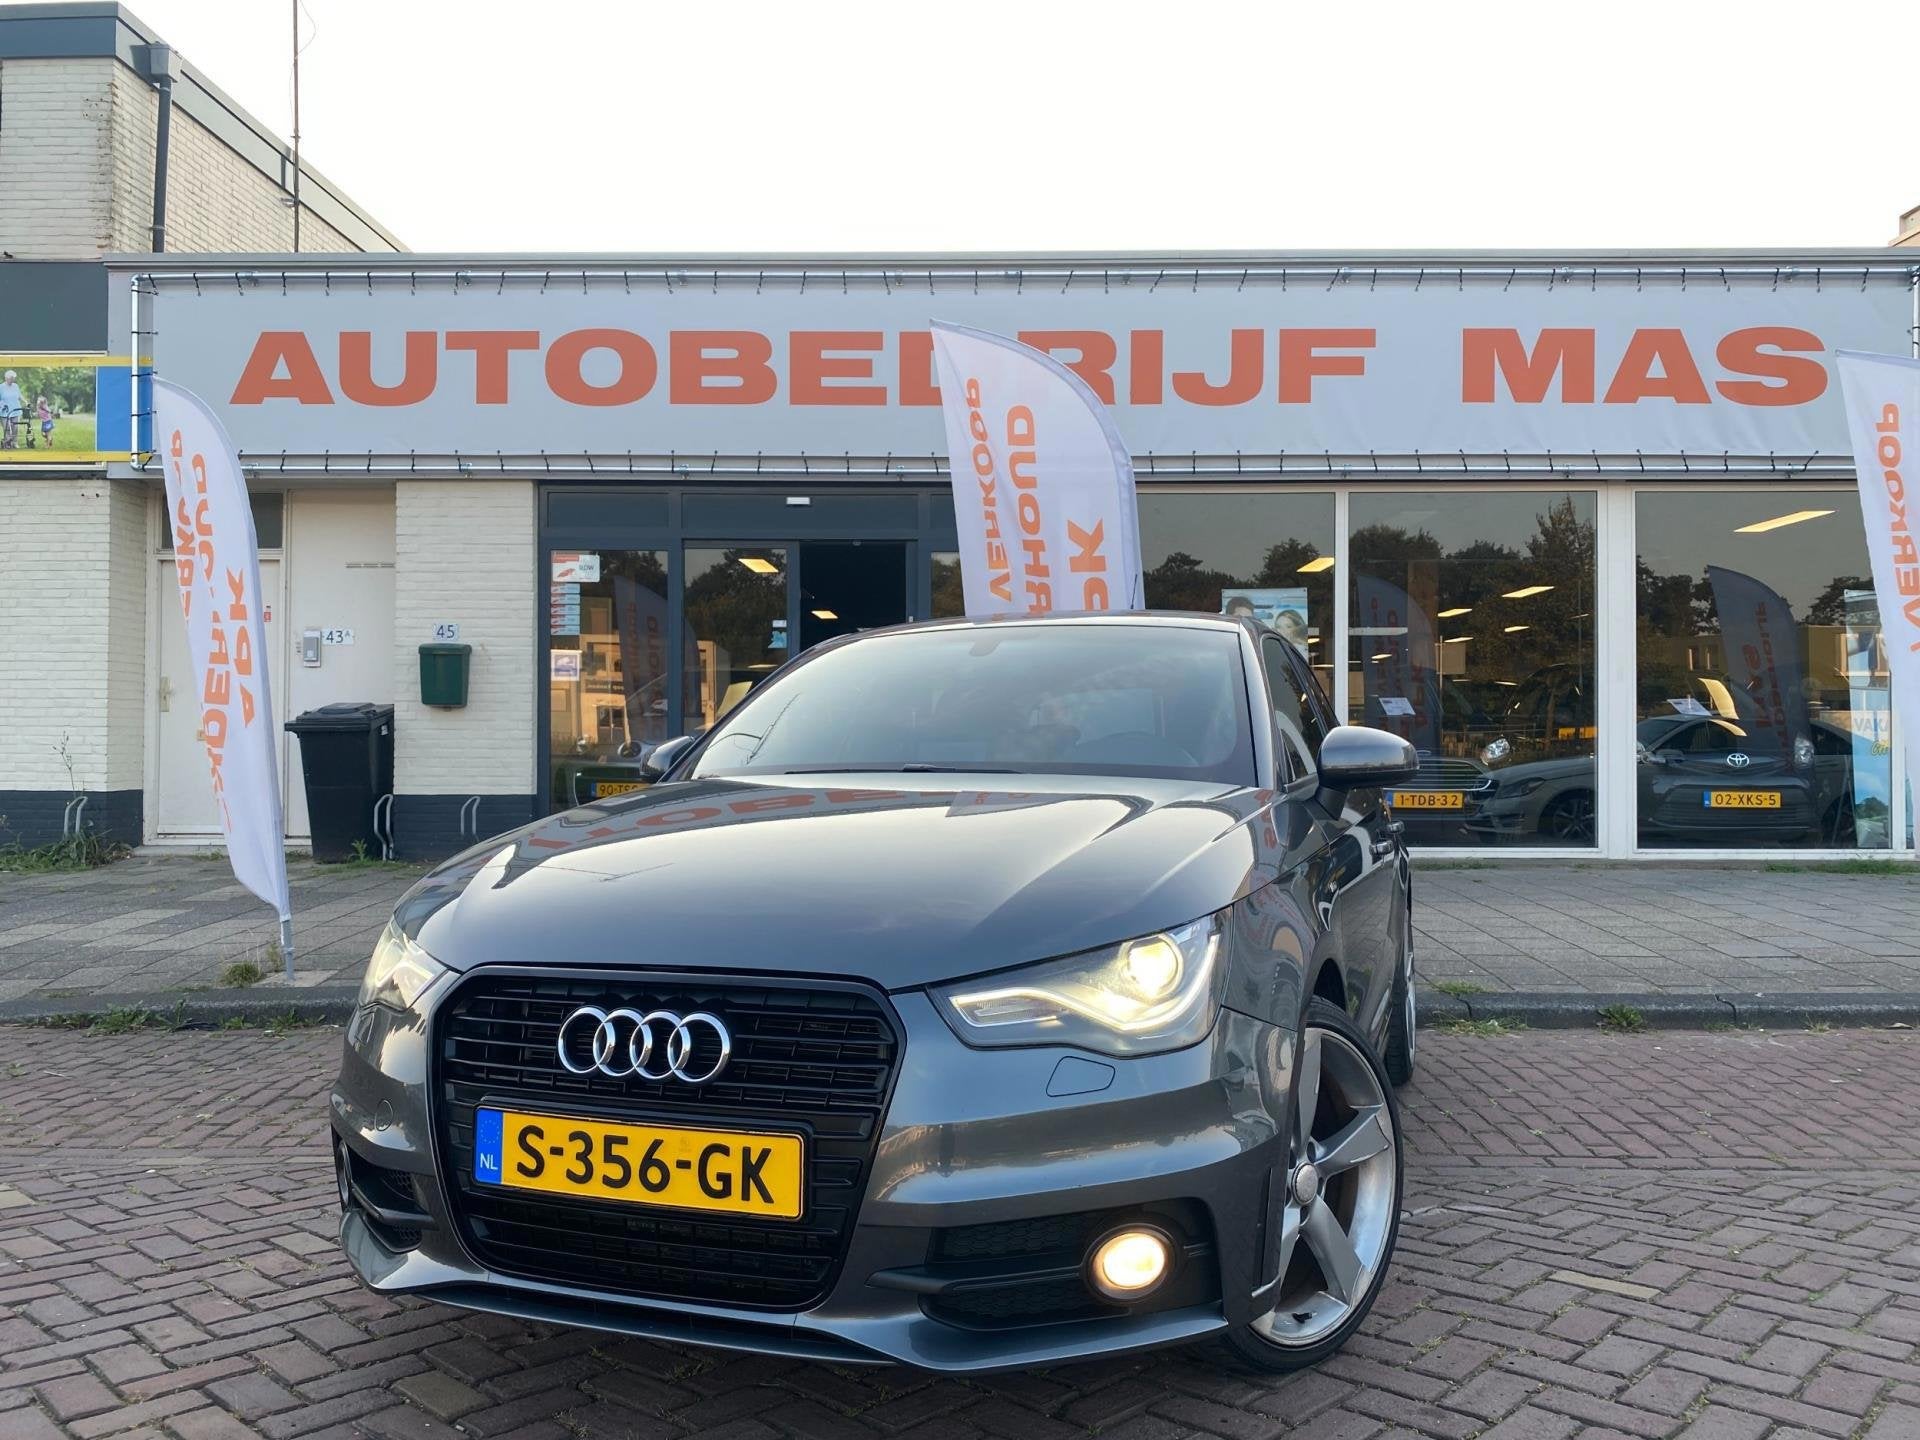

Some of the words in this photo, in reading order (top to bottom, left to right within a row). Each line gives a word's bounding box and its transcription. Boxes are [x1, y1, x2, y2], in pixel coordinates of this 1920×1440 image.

[1462, 327, 1828, 406] MAS
[436, 624, 455, 639] 45
[1714, 793, 1777, 806] 02-XKS-5
[480, 1153, 498, 1171] NL
[516, 1124, 775, 1204] S-356-GK
